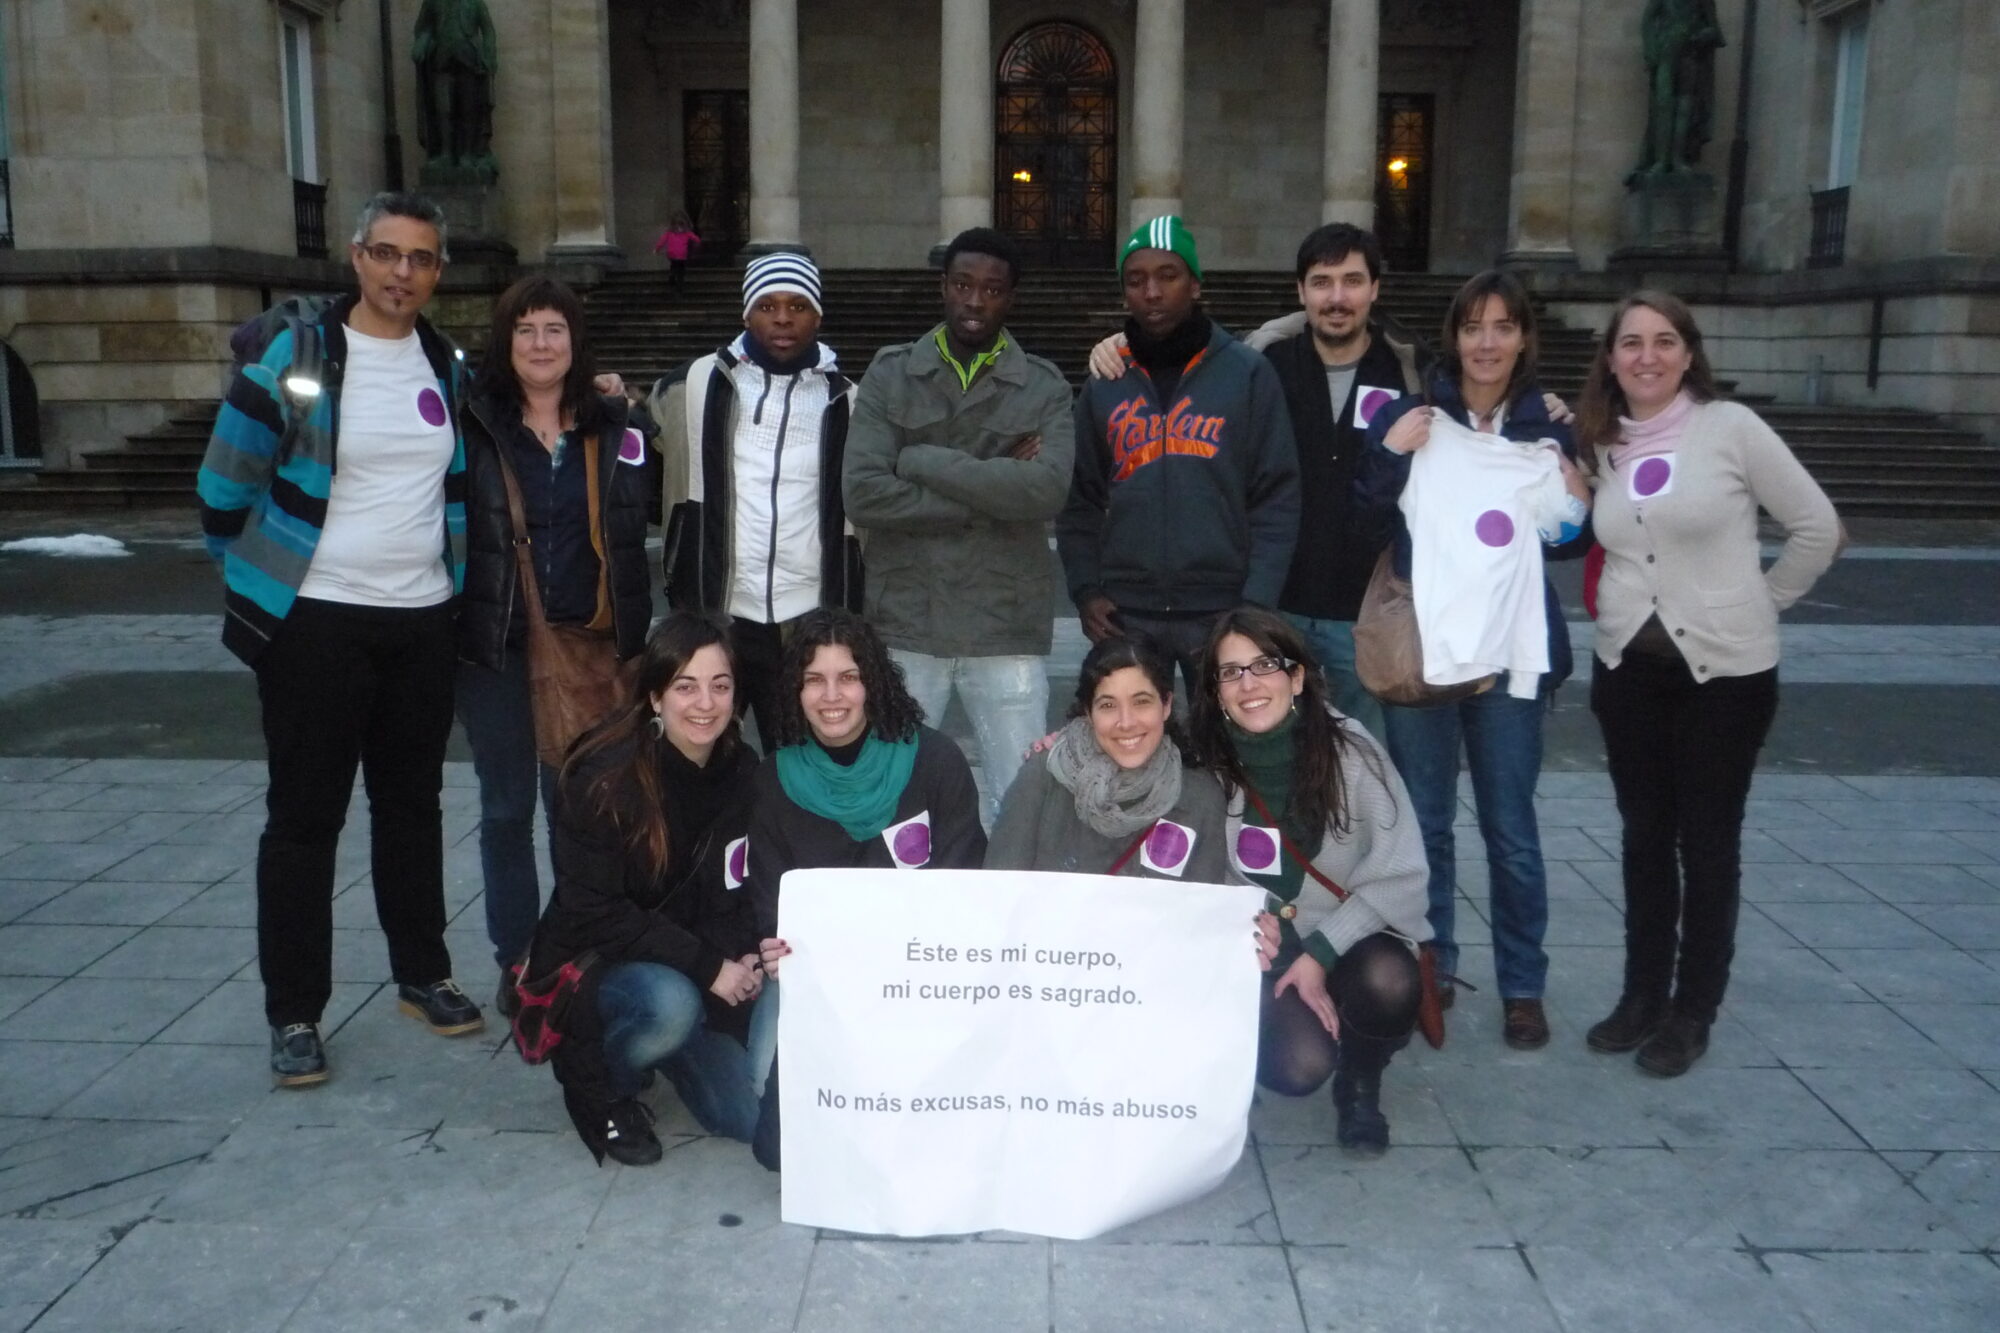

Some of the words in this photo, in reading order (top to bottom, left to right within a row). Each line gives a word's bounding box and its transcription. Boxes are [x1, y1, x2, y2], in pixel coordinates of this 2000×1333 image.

[1107, 394, 1226, 467] Harlem
[906, 936, 958, 963] Éste
[965, 948, 993, 963] es
[1000, 943, 1027, 963] mi
[1034, 949, 1122, 971] cuerpo,
[882, 979, 911, 999] mi
[919, 984, 1001, 1005] cuerpo
[1008, 984, 1033, 1000] es
[1040, 984, 1143, 1008] sagrado.
[817, 1087, 847, 1110] No
[854, 1092, 902, 1113] más
[910, 1094, 1012, 1113] excusas,
[1020, 1095, 1049, 1112] no
[1056, 1096, 1105, 1118] más
[1112, 1097, 1198, 1120] abusos
